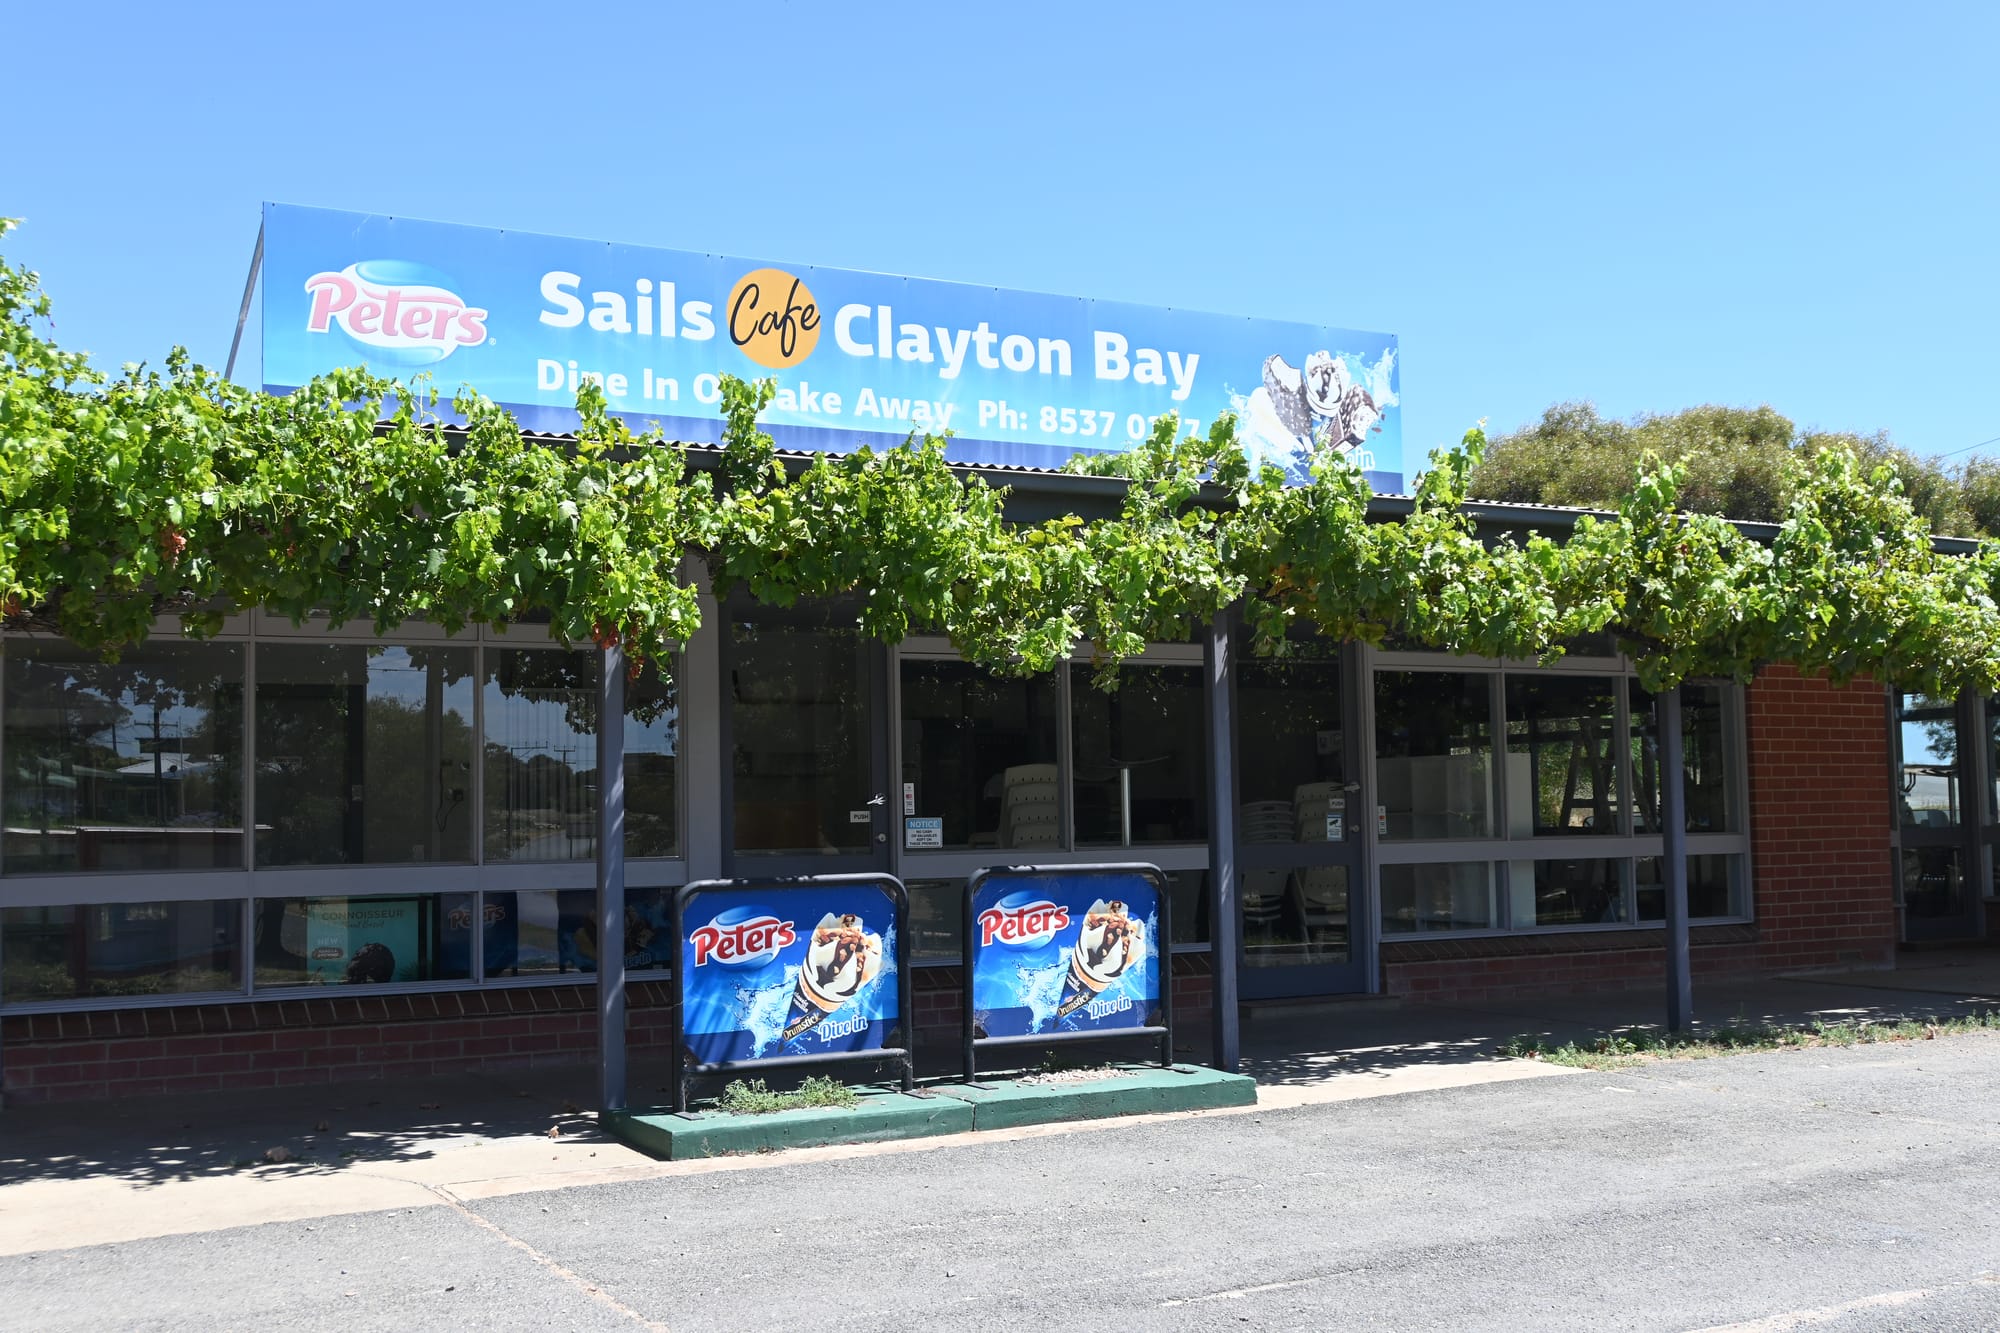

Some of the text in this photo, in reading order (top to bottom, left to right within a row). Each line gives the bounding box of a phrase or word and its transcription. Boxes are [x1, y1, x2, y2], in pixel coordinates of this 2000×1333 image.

[306, 271, 488, 346] Peters
[538, 270, 1201, 399] Sails Cafe Clayton Bay
[643, 368, 679, 401] In
[692, 373, 724, 405] O
[752, 378, 842, 414] ake
[854, 387, 953, 430] Away
[978, 399, 1028, 430] Ph:
[1039, 405, 1115, 438] 8537
[1126, 413, 1201, 441] 07
[909, 820, 938, 828] NOTICE
[320, 908, 405, 921] CONNOISSEUR
[448, 904, 506, 929] Pers
[978, 905, 1070, 947] Peters
[690, 920, 796, 967] Peters
[1057, 992, 1091, 1018] Drumstick
[1089, 995, 1132, 1020] Dive in
[782, 1012, 820, 1042] Drumstick
[819, 1019, 850, 1042] Dive
[851, 1014, 868, 1033] in
